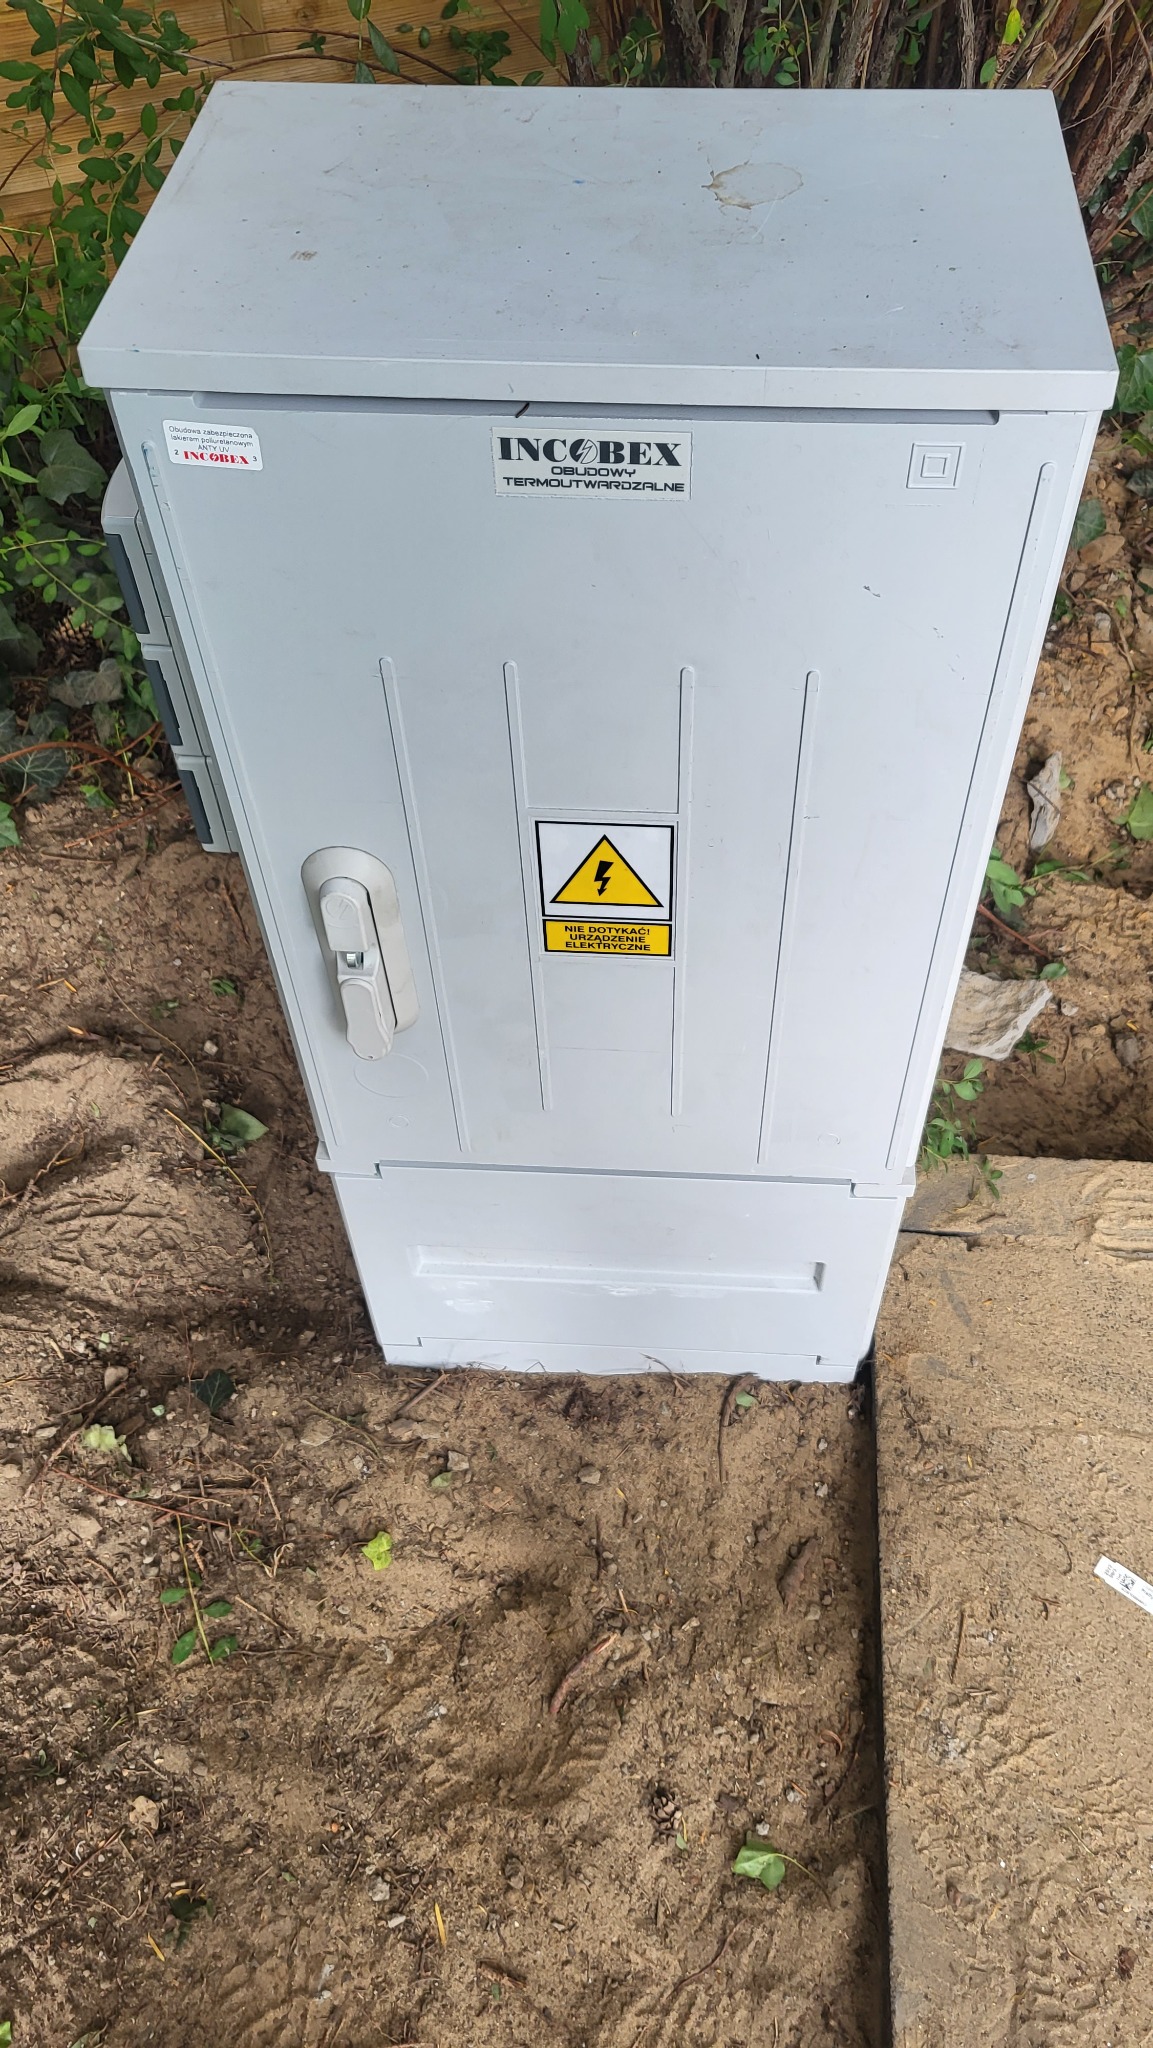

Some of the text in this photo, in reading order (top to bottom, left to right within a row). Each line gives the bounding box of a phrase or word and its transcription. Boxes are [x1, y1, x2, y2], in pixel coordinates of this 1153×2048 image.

[168, 426, 253, 439] Obudowa zabezpieczona
[170, 434, 254, 448] lakierem poliuretanowym
[183, 451, 249, 464] INCOBEX
[496, 436, 683, 467] INCOBEX
[551, 466, 636, 478] OBUDOWY
[502, 476, 685, 493] TERMOUTWARDZALNE
[564, 925, 650, 936] NIE DOTYKAĆ!
[565, 941, 651, 951] ELEKTRYCZNE
[569, 934, 646, 945] URZĄDZENIE
